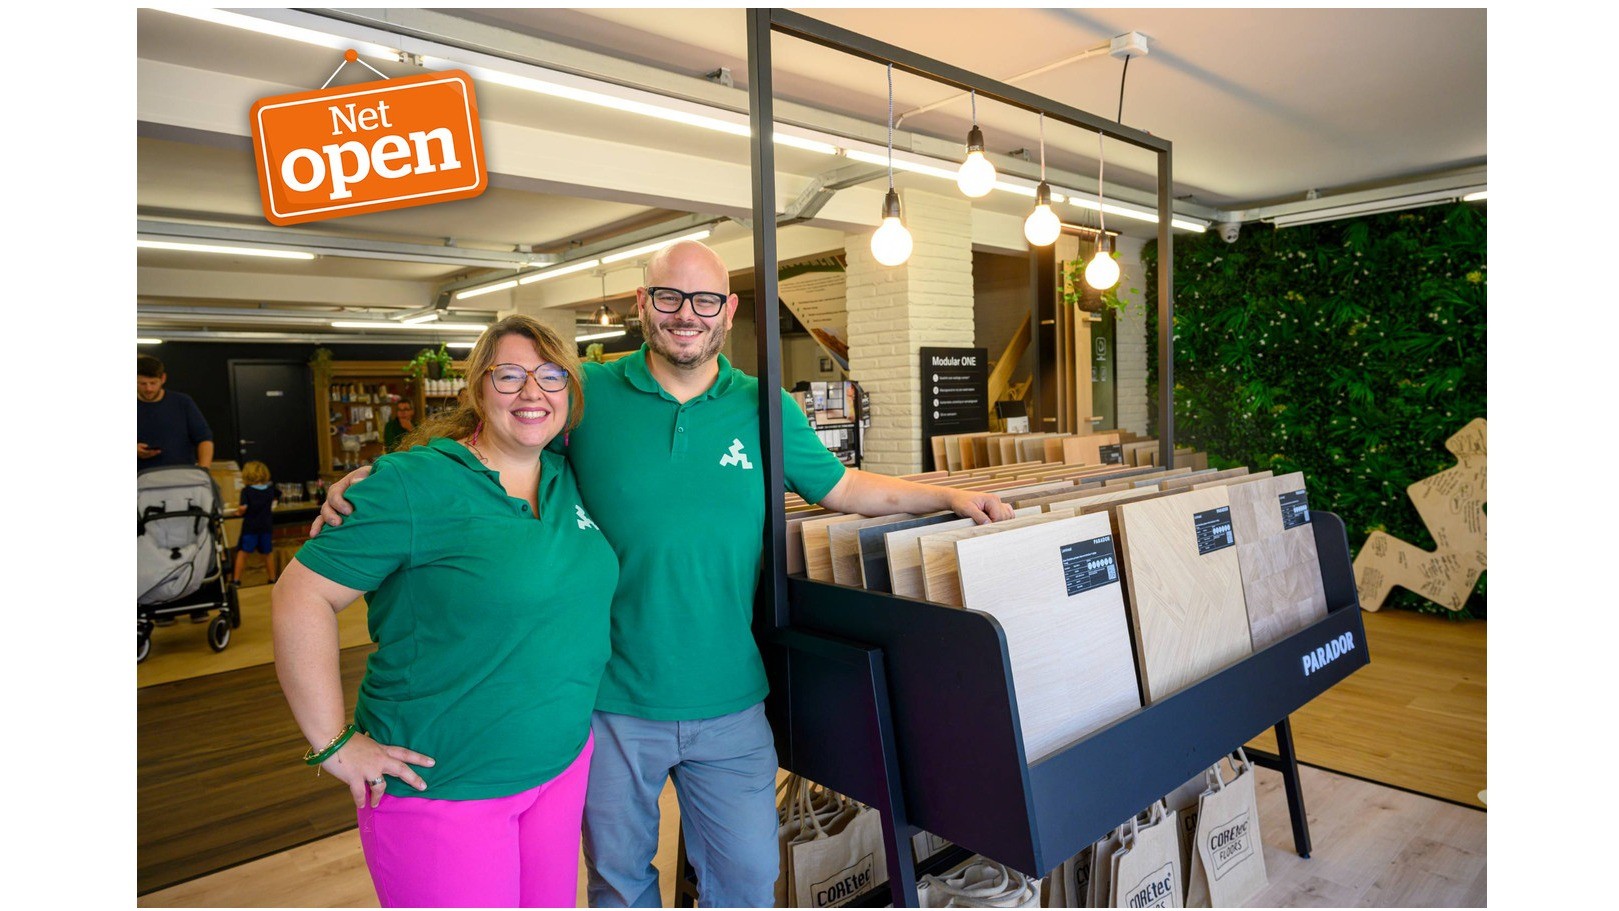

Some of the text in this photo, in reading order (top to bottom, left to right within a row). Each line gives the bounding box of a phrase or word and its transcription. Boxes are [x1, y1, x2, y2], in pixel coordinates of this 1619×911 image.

[932, 356, 976, 366] Modular ONE
[1302, 631, 1355, 676] PARADOR
[1211, 821, 1248, 851] COREtec
[1219, 840, 1242, 861] FLOORS
[817, 868, 870, 906] COREtec
